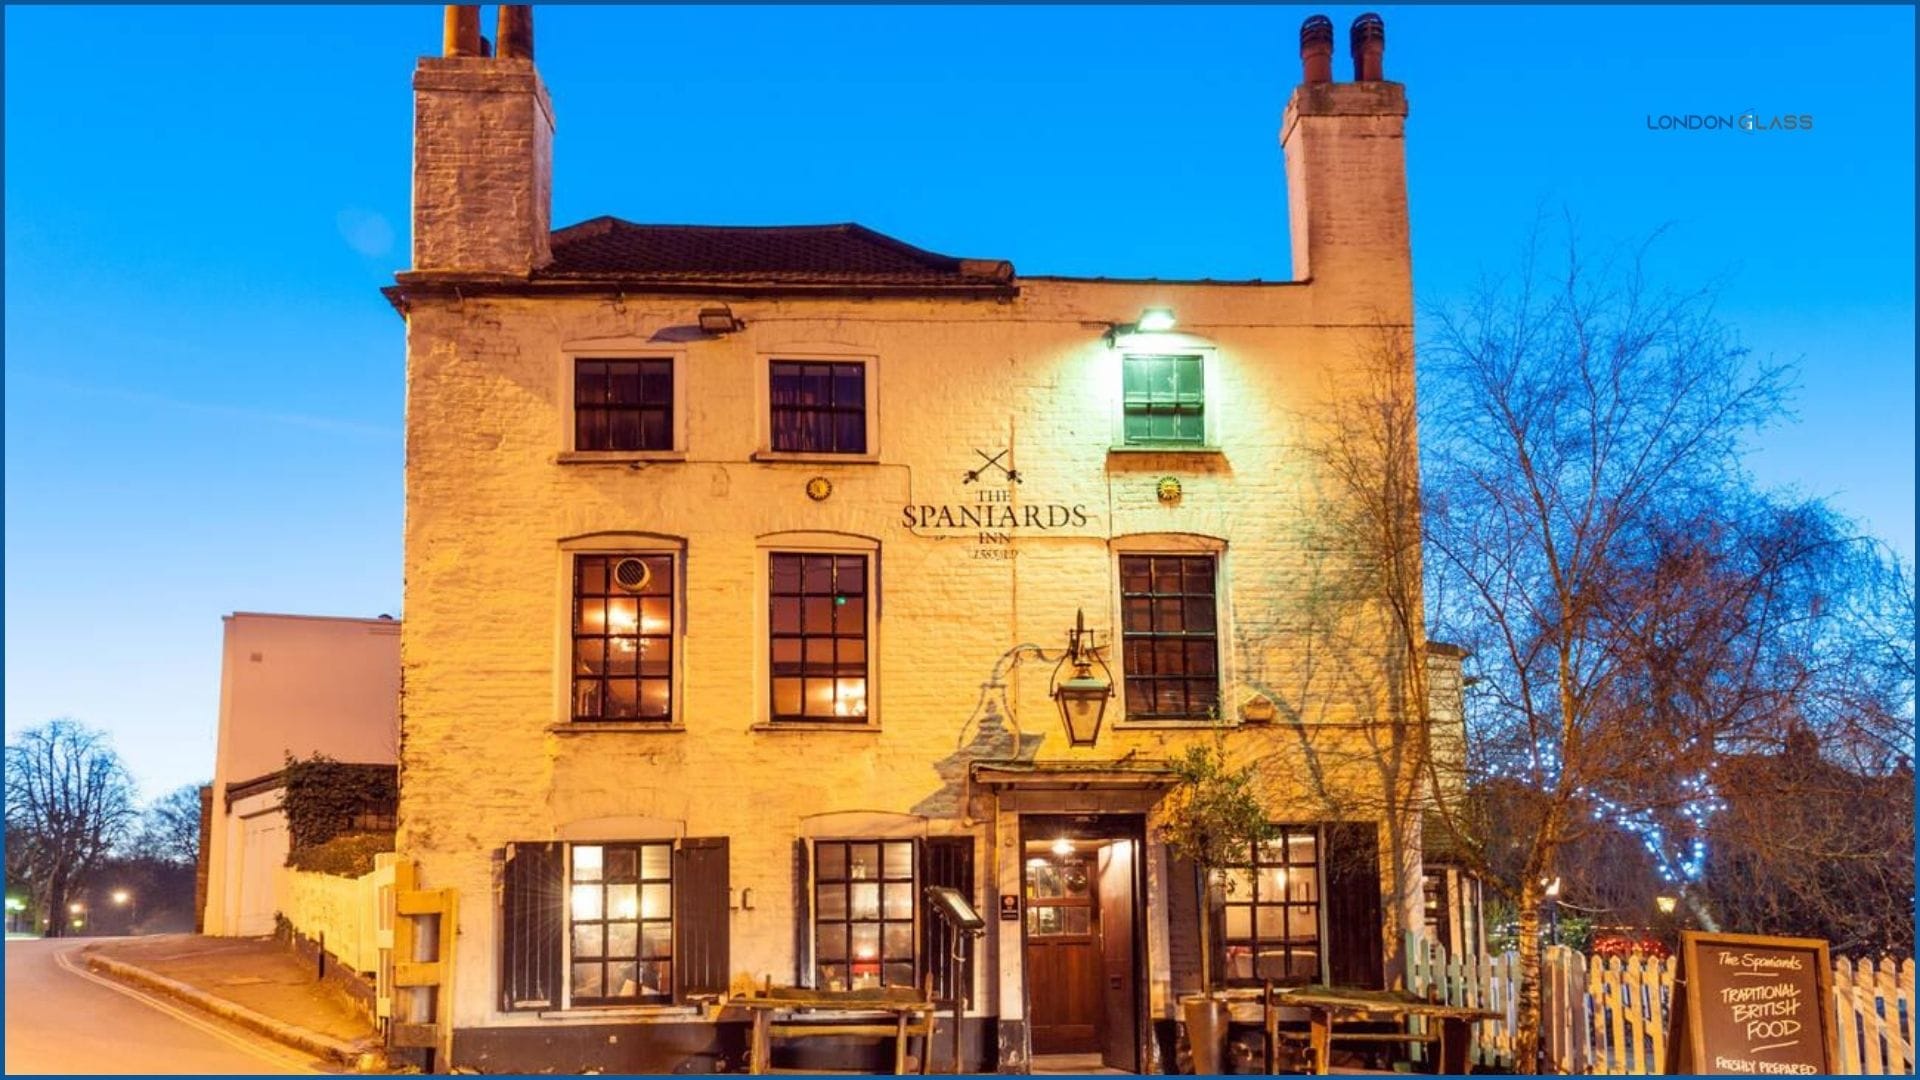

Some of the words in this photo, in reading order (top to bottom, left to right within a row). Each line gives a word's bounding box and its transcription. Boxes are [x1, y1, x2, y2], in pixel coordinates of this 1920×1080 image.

[976, 489, 1012, 502] THE
[902, 504, 1088, 530] SPANIARDS
[979, 532, 1012, 545] INN
[1718, 951, 1740, 966] The
[1741, 953, 1803, 972] Spaniards
[1720, 982, 1801, 1003] TRADITIONAL
[1732, 998, 1801, 1023] BRITISH
[1747, 1019, 1801, 1041] FOOD
[1716, 1056, 1756, 1074] FRESHLY
[1759, 1061, 1818, 1075] PREPARED
